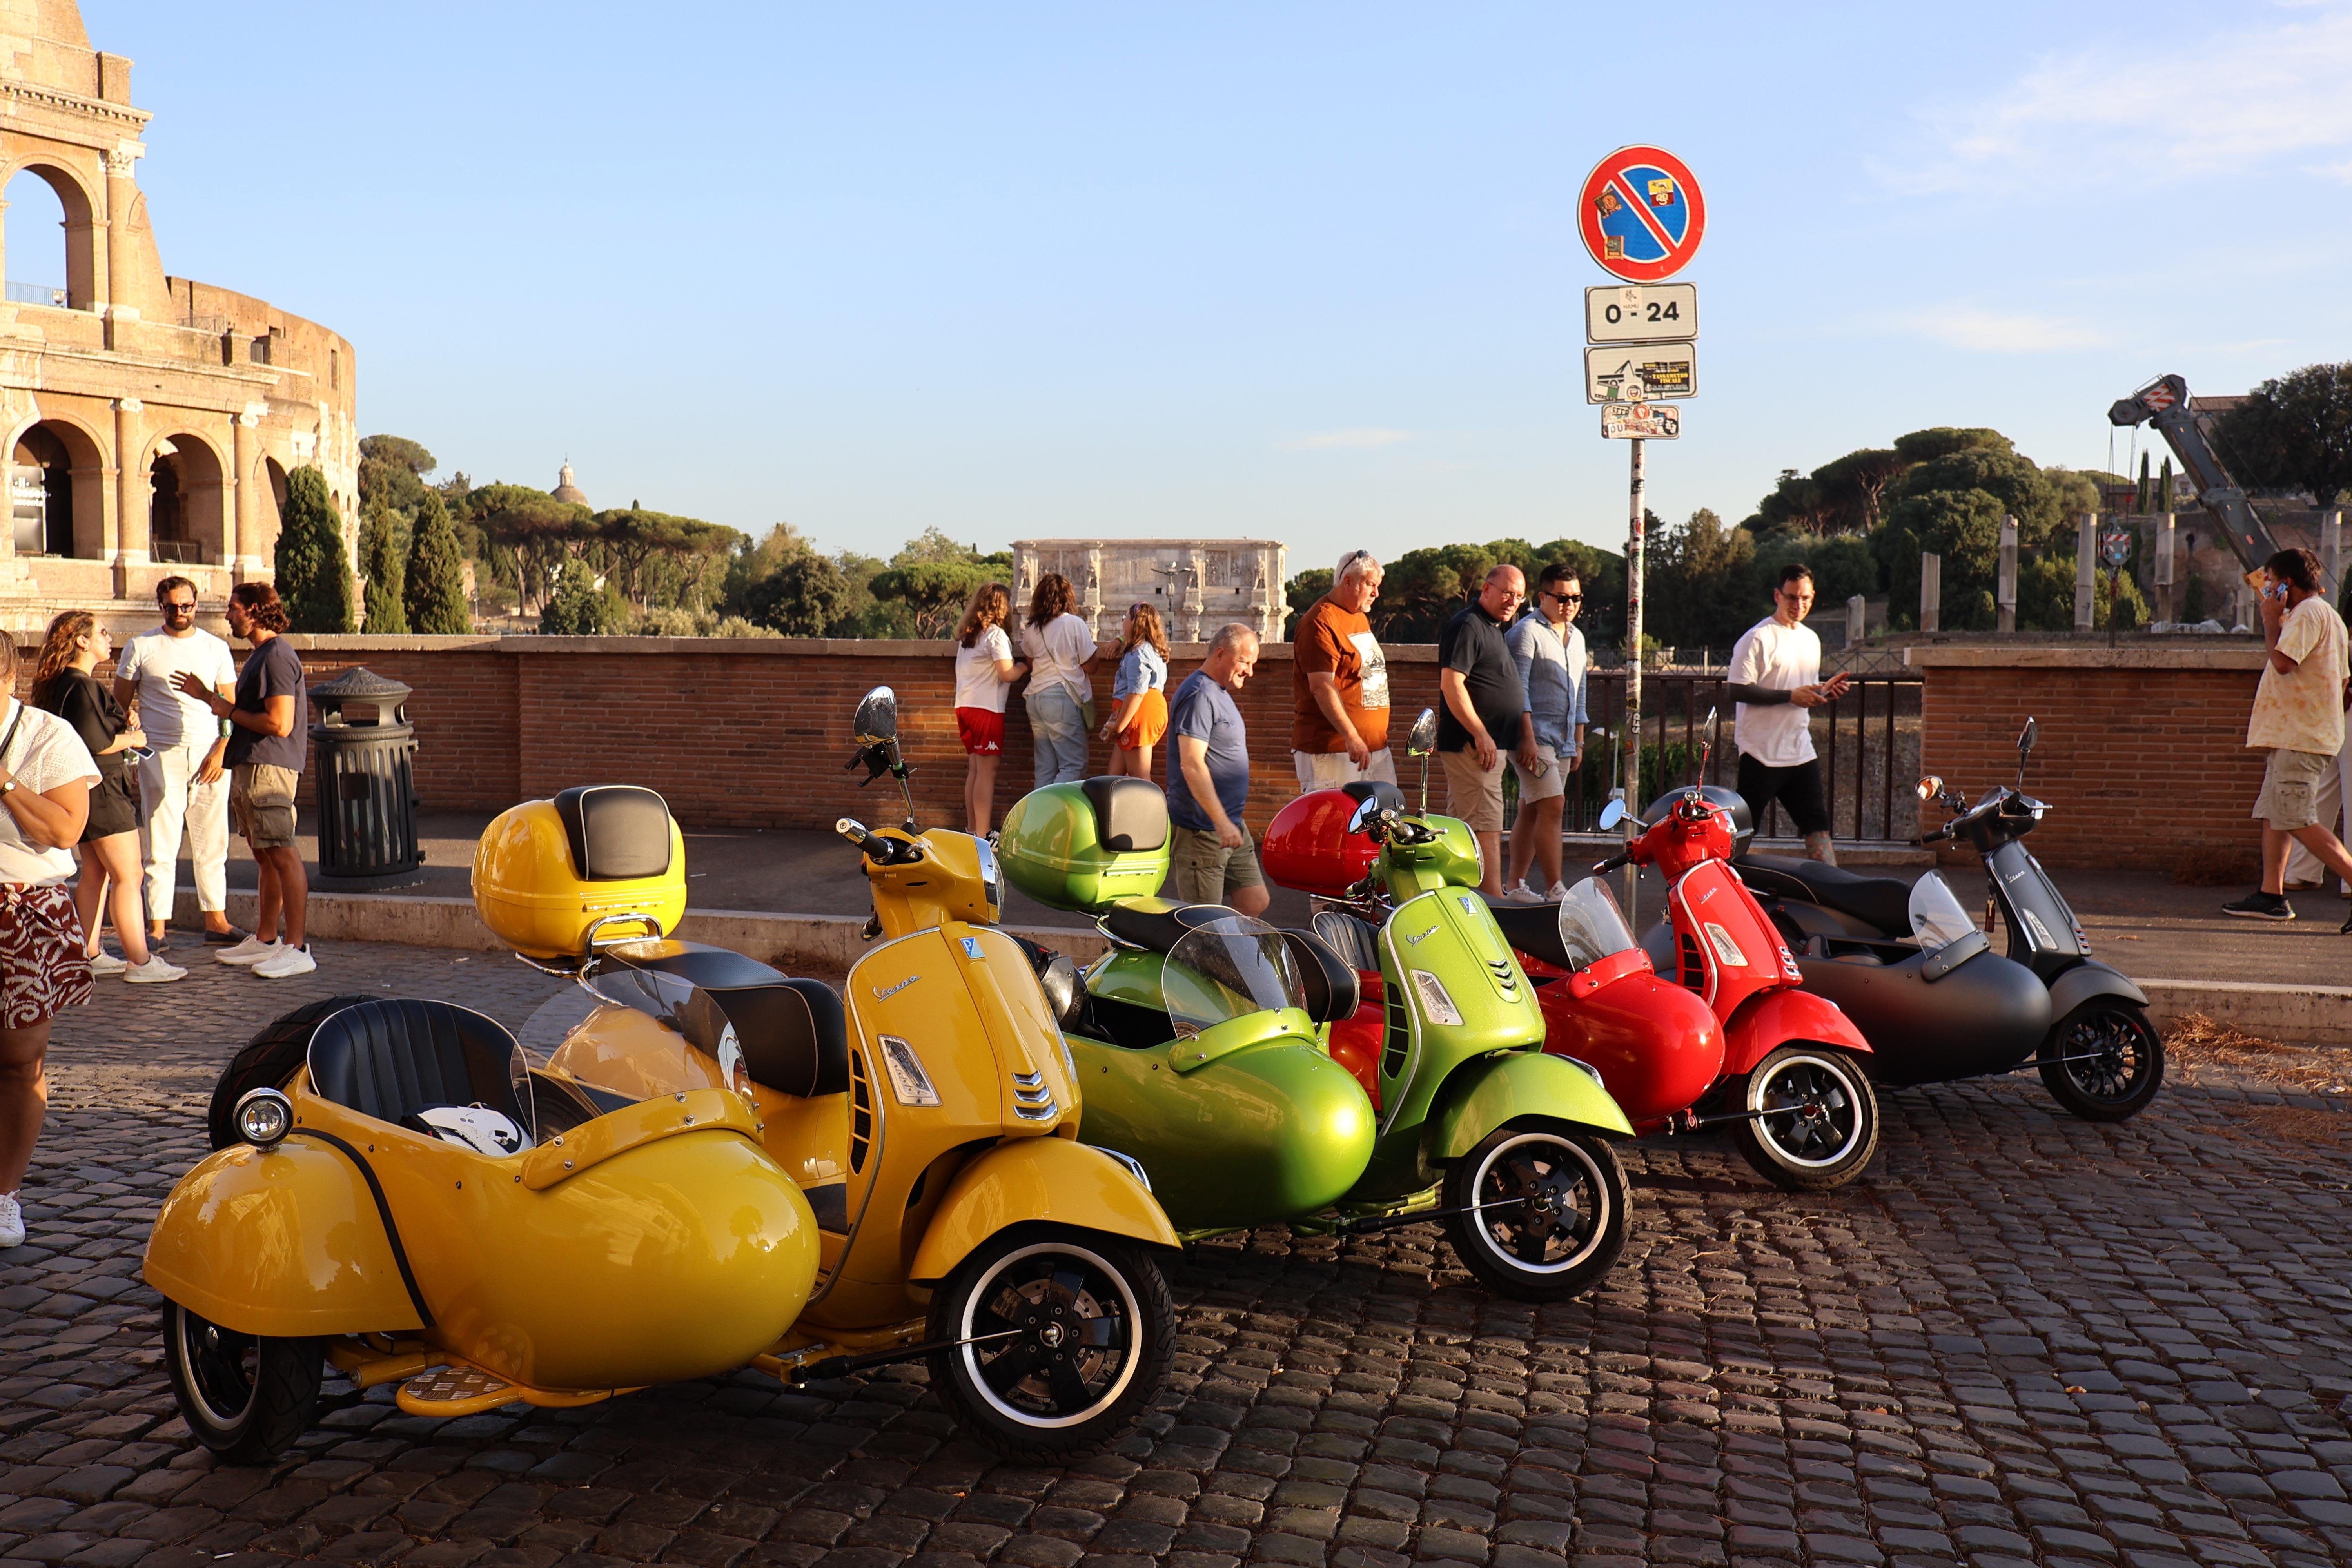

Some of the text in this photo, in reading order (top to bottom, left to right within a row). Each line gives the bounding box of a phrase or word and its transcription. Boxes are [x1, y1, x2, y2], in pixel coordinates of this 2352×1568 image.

[1606, 304, 1621, 324] 0
[1646, 301, 1679, 322] 24
[962, 940, 972, 952] P
[1406, 925, 1441, 947] Vespa
[873, 975, 922, 1004] Vespa
